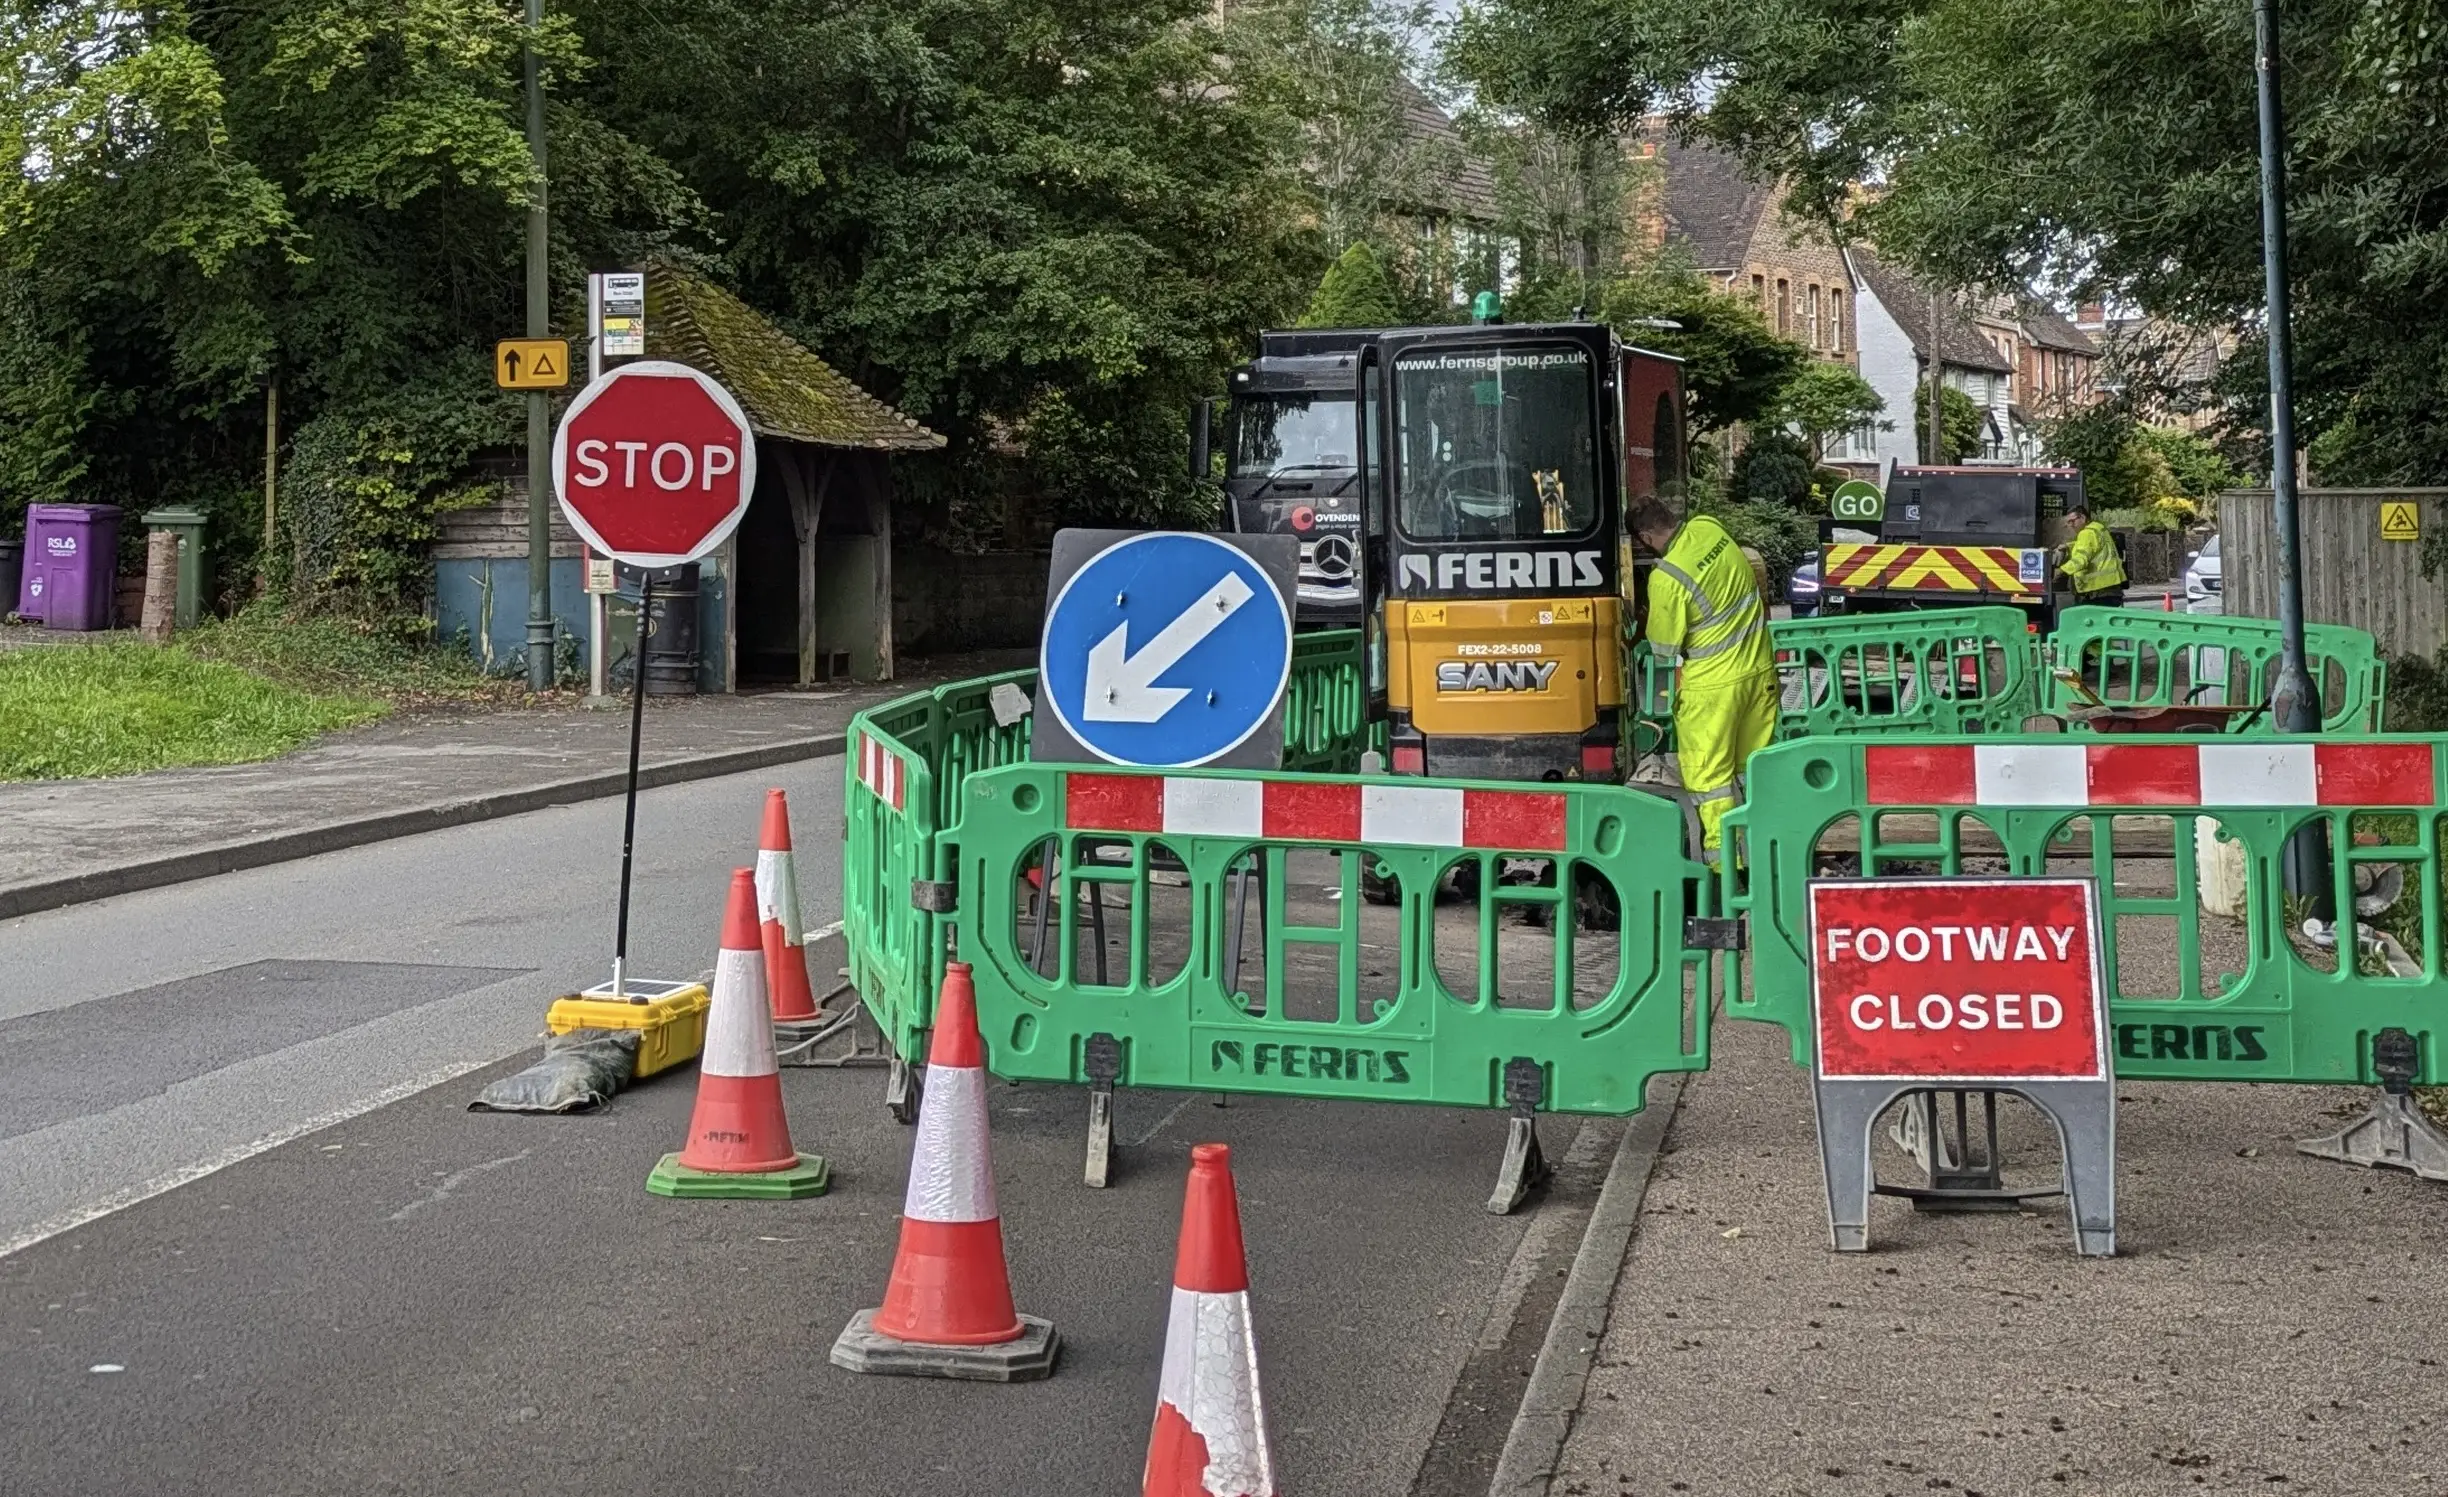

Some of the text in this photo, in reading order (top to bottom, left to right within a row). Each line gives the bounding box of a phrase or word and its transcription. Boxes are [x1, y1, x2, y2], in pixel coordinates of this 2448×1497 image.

[1395, 351, 1588, 371] www.fernsgroup.co.uk
[574, 439, 735, 491] STOP
[1315, 513, 1360, 522] OVENDEN
[1838, 495, 1878, 516] GO
[1437, 551, 1604, 589] FERNS
[1457, 644, 1542, 655] FEX2-22-5008
[1438, 661, 1560, 691] SANY
[1827, 925, 2075, 963] FOOTWAY
[1849, 993, 2064, 1031] CLOSED
[2111, 1024, 2268, 1061] ERNS
[1253, 1042, 1411, 1084] FERNS
